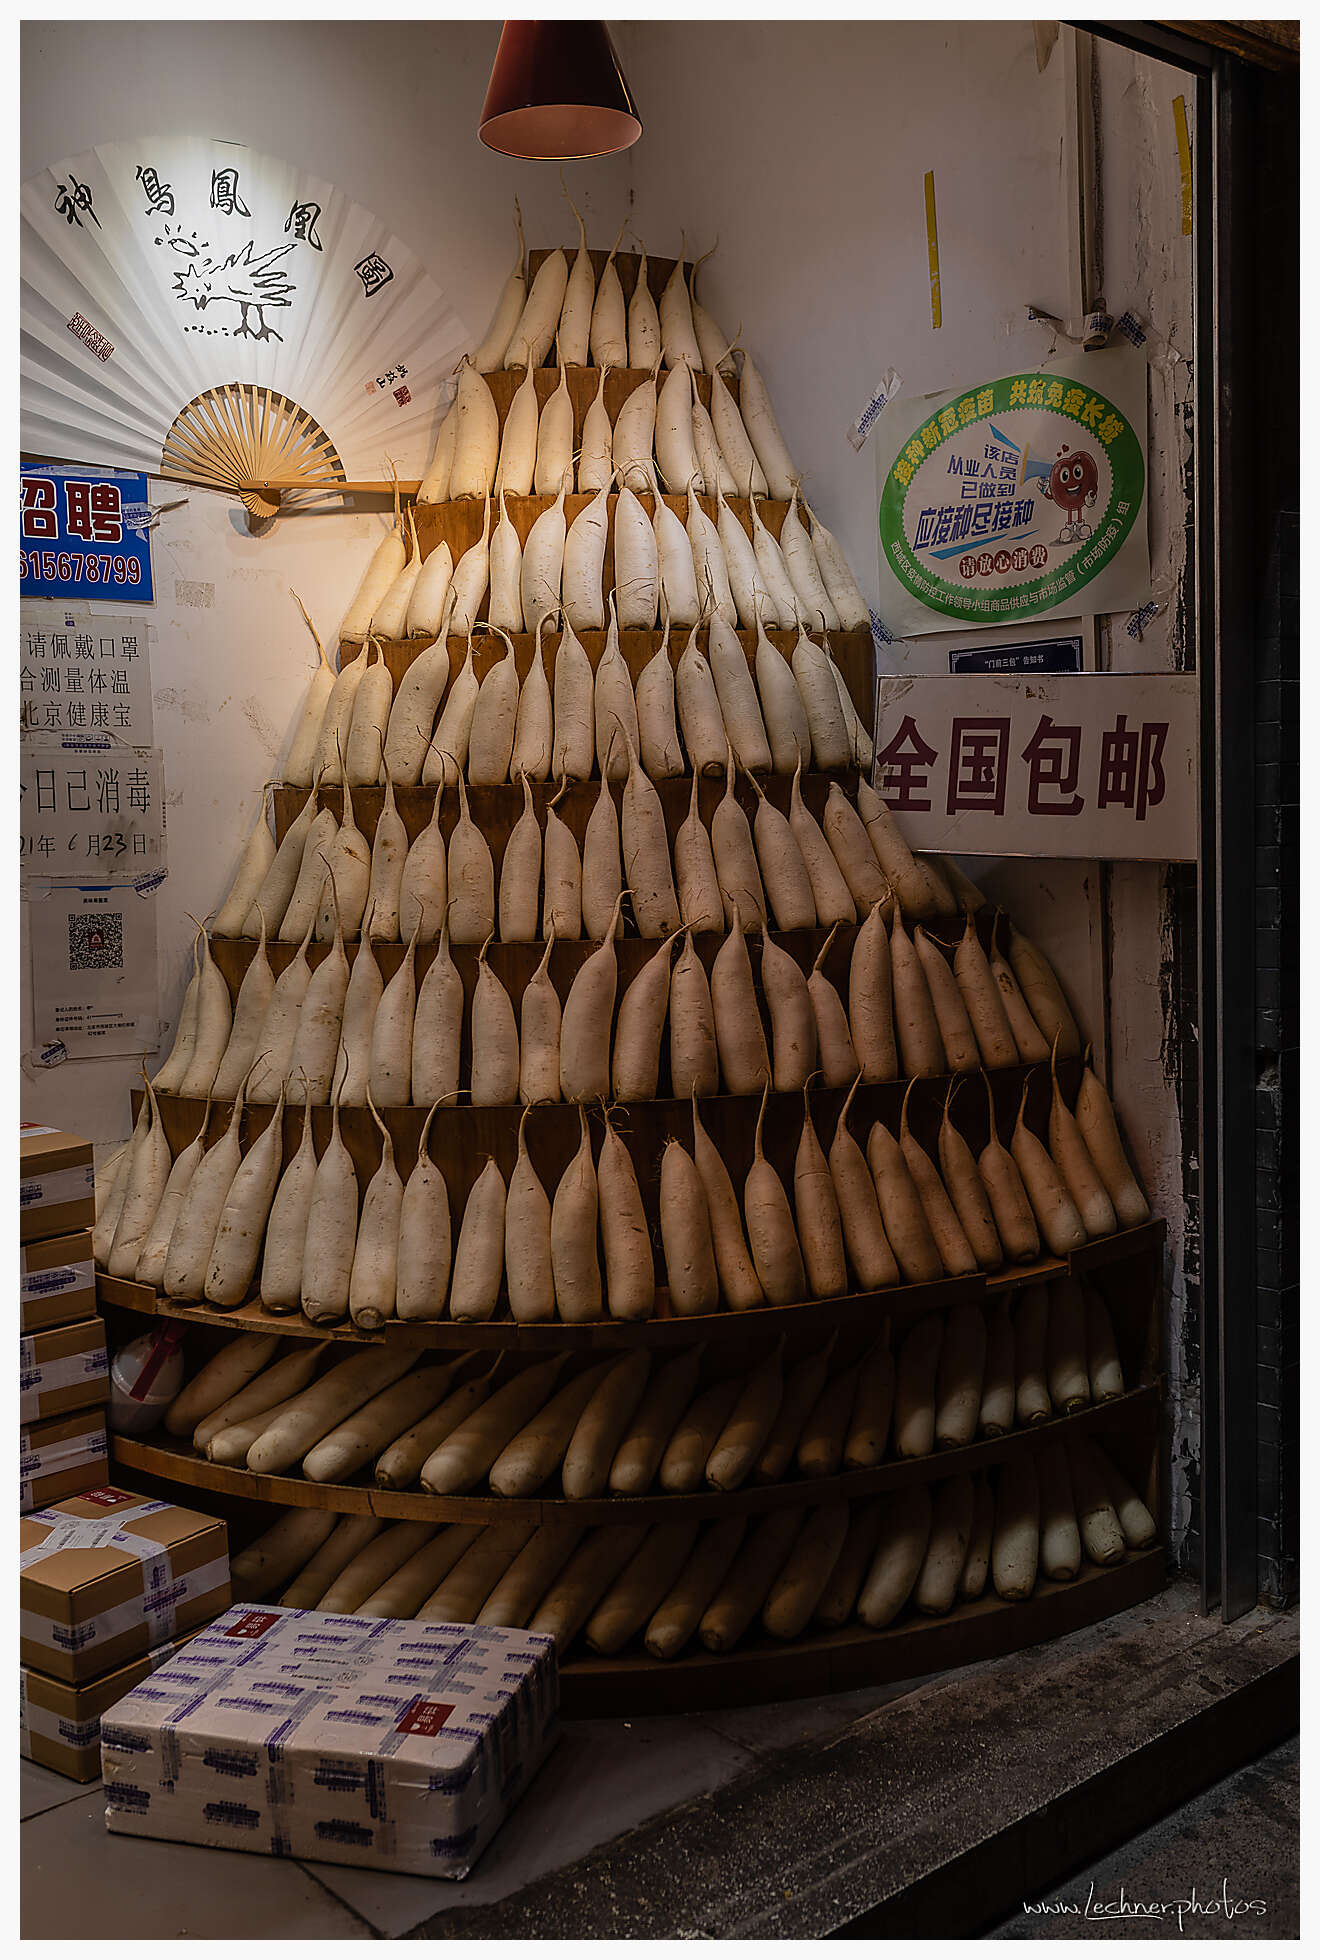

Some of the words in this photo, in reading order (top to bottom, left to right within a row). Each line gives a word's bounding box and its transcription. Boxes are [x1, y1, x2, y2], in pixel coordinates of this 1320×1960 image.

[947, 454, 1017, 481] 从业人员
[984, 444, 1019, 466] 该店
[961, 481, 1015, 499] 已做到
[20, 477, 123, 543] 招聘
[913, 499, 1035, 551] 应接种尽接种
[959, 544, 1049, 579] 请放心消费
[20, 631, 139, 662] 请佩戴口罩
[20, 700, 132, 728] 北京健康宝
[876, 714, 1170, 821] 全国包邮
[20, 768, 151, 814] 日已消毒
